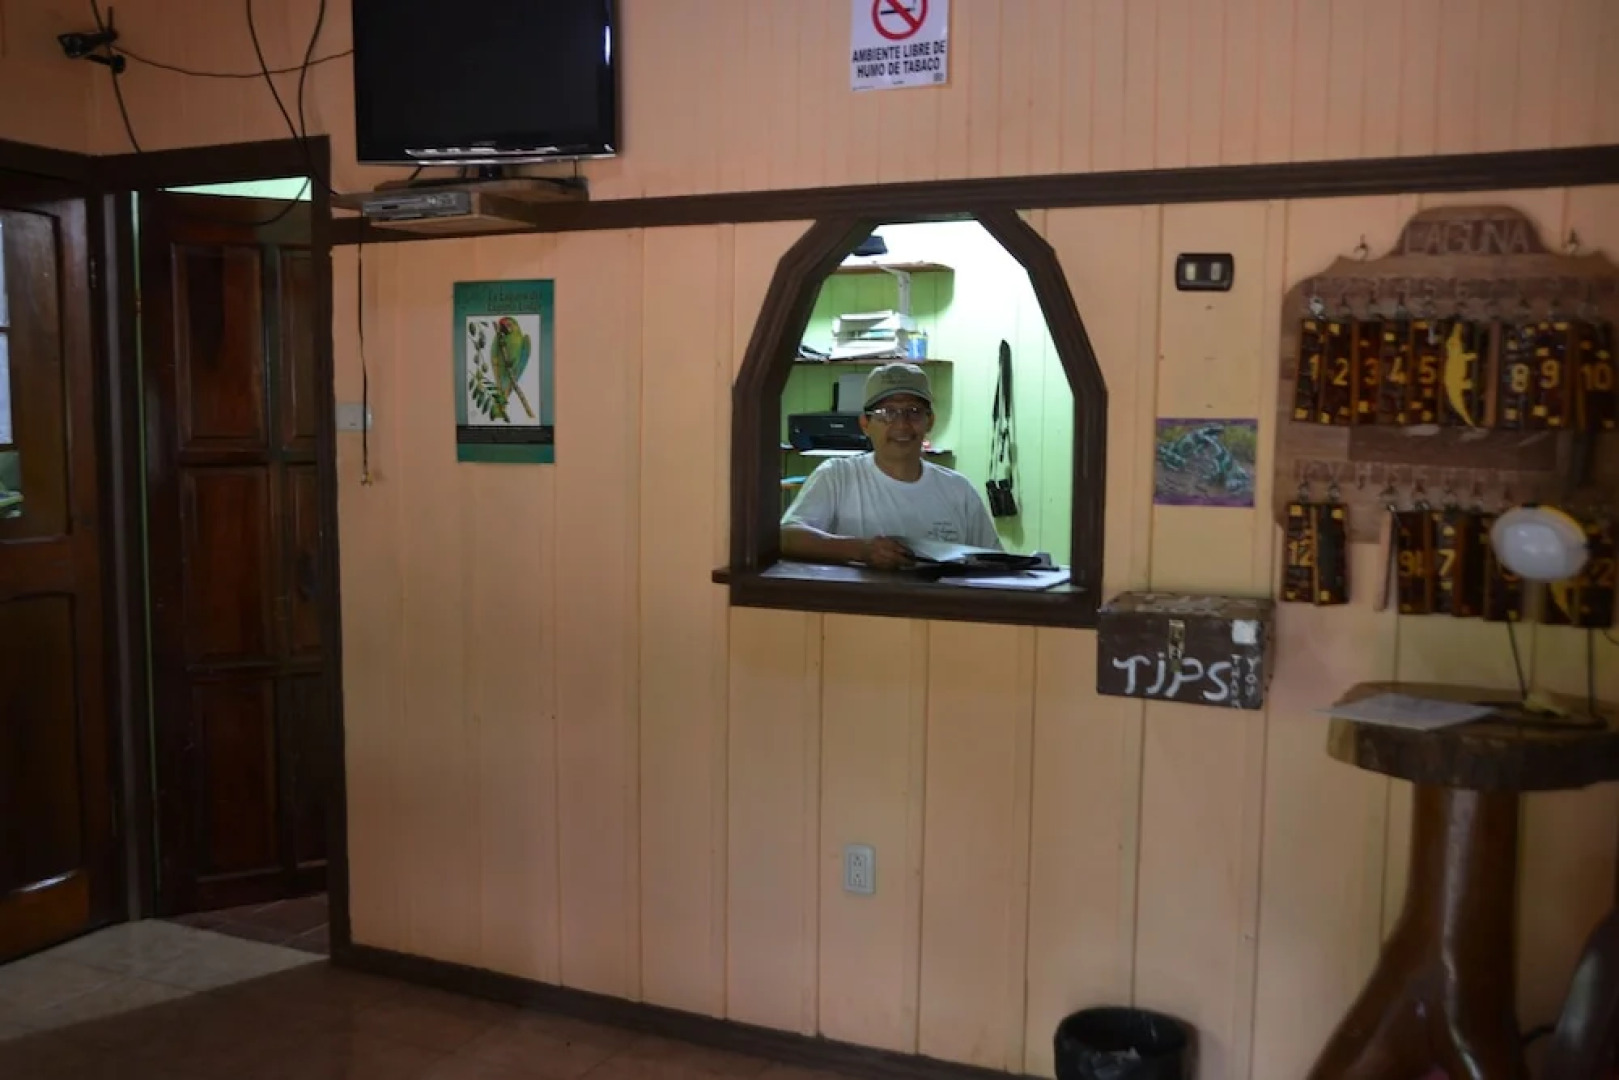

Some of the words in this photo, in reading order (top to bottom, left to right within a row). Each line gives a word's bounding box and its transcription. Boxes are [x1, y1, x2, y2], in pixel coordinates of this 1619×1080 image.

[853, 45, 900, 62] AMBIENTE
[903, 42, 930, 57] LIBRE
[933, 40, 945, 54] DE
[858, 63, 884, 78] HUMO
[889, 61, 900, 75] DE
[903, 57, 940, 74] TABACO
[1404, 220, 1530, 252] LAGUNA
[1308, 354, 1320, 380] 1
[1333, 358, 1348, 385] 2
[1365, 358, 1379, 385] 3
[1389, 357, 1406, 384] 4
[1419, 356, 1437, 384] 5
[1511, 363, 1529, 392] 8
[1541, 359, 1559, 388] 9
[1580, 363, 1612, 390] 10
[1438, 549, 1456, 576] 7
[1244, 657, 1262, 697] YOU
